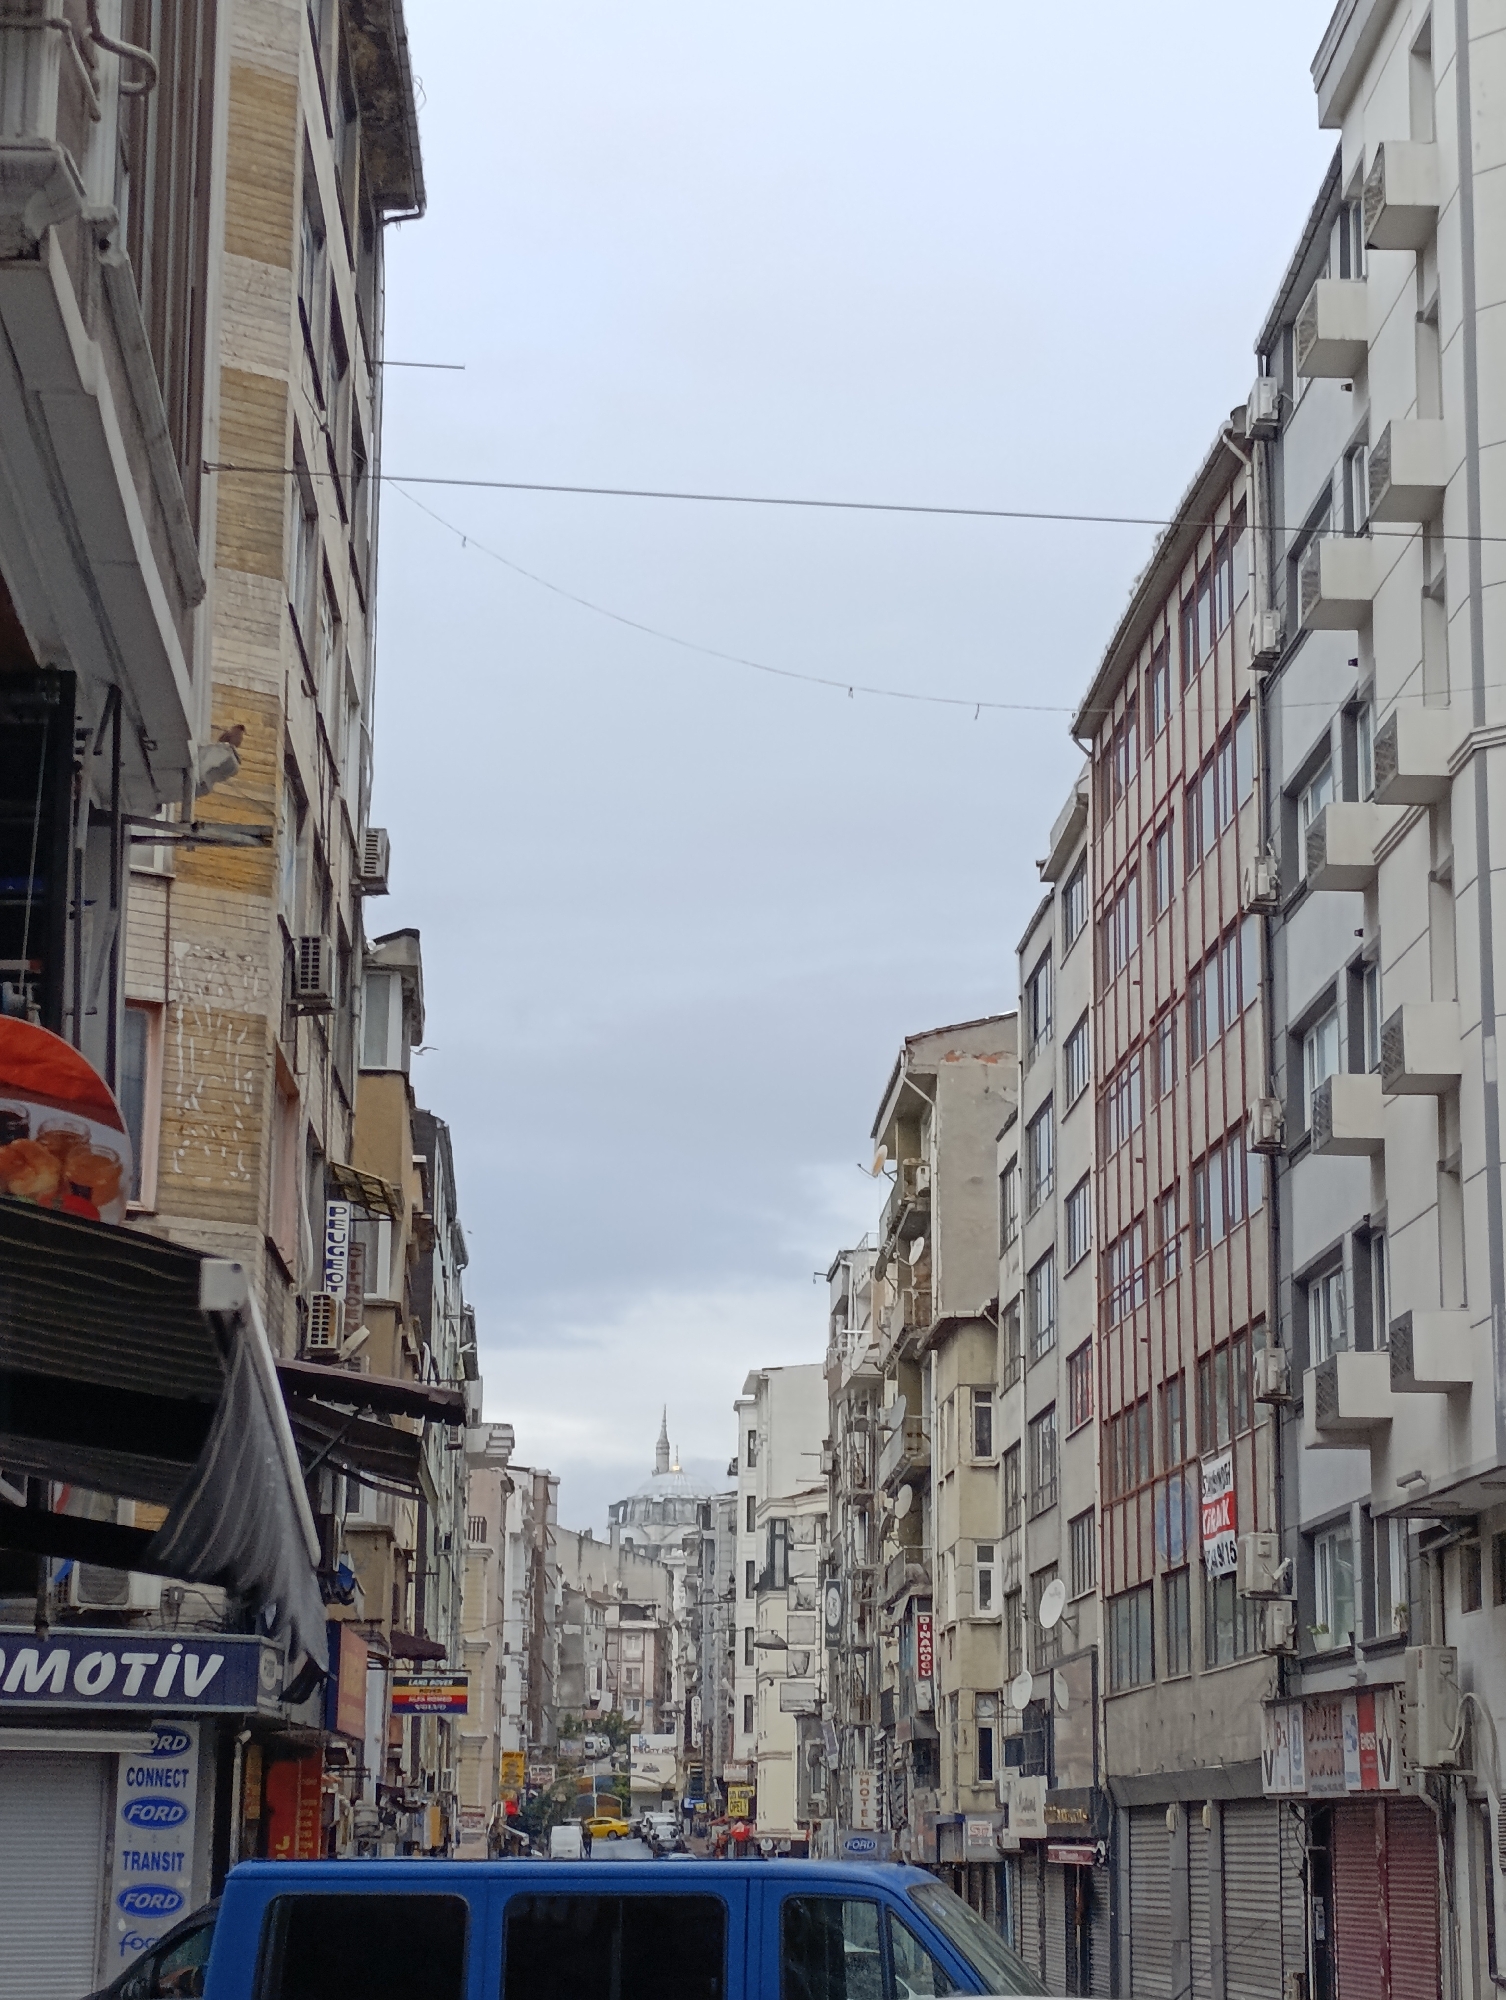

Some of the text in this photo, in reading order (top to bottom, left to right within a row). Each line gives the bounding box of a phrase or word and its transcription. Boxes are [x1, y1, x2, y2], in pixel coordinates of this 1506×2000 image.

[126, 1767, 189, 1788] CONNECT
[859, 1778, 870, 1827] HOTEL
[127, 1804, 185, 1822] FORD
[846, 1840, 875, 1850] FORD
[122, 1851, 185, 1872] TRANSIT
[123, 1892, 181, 1910] FORD
